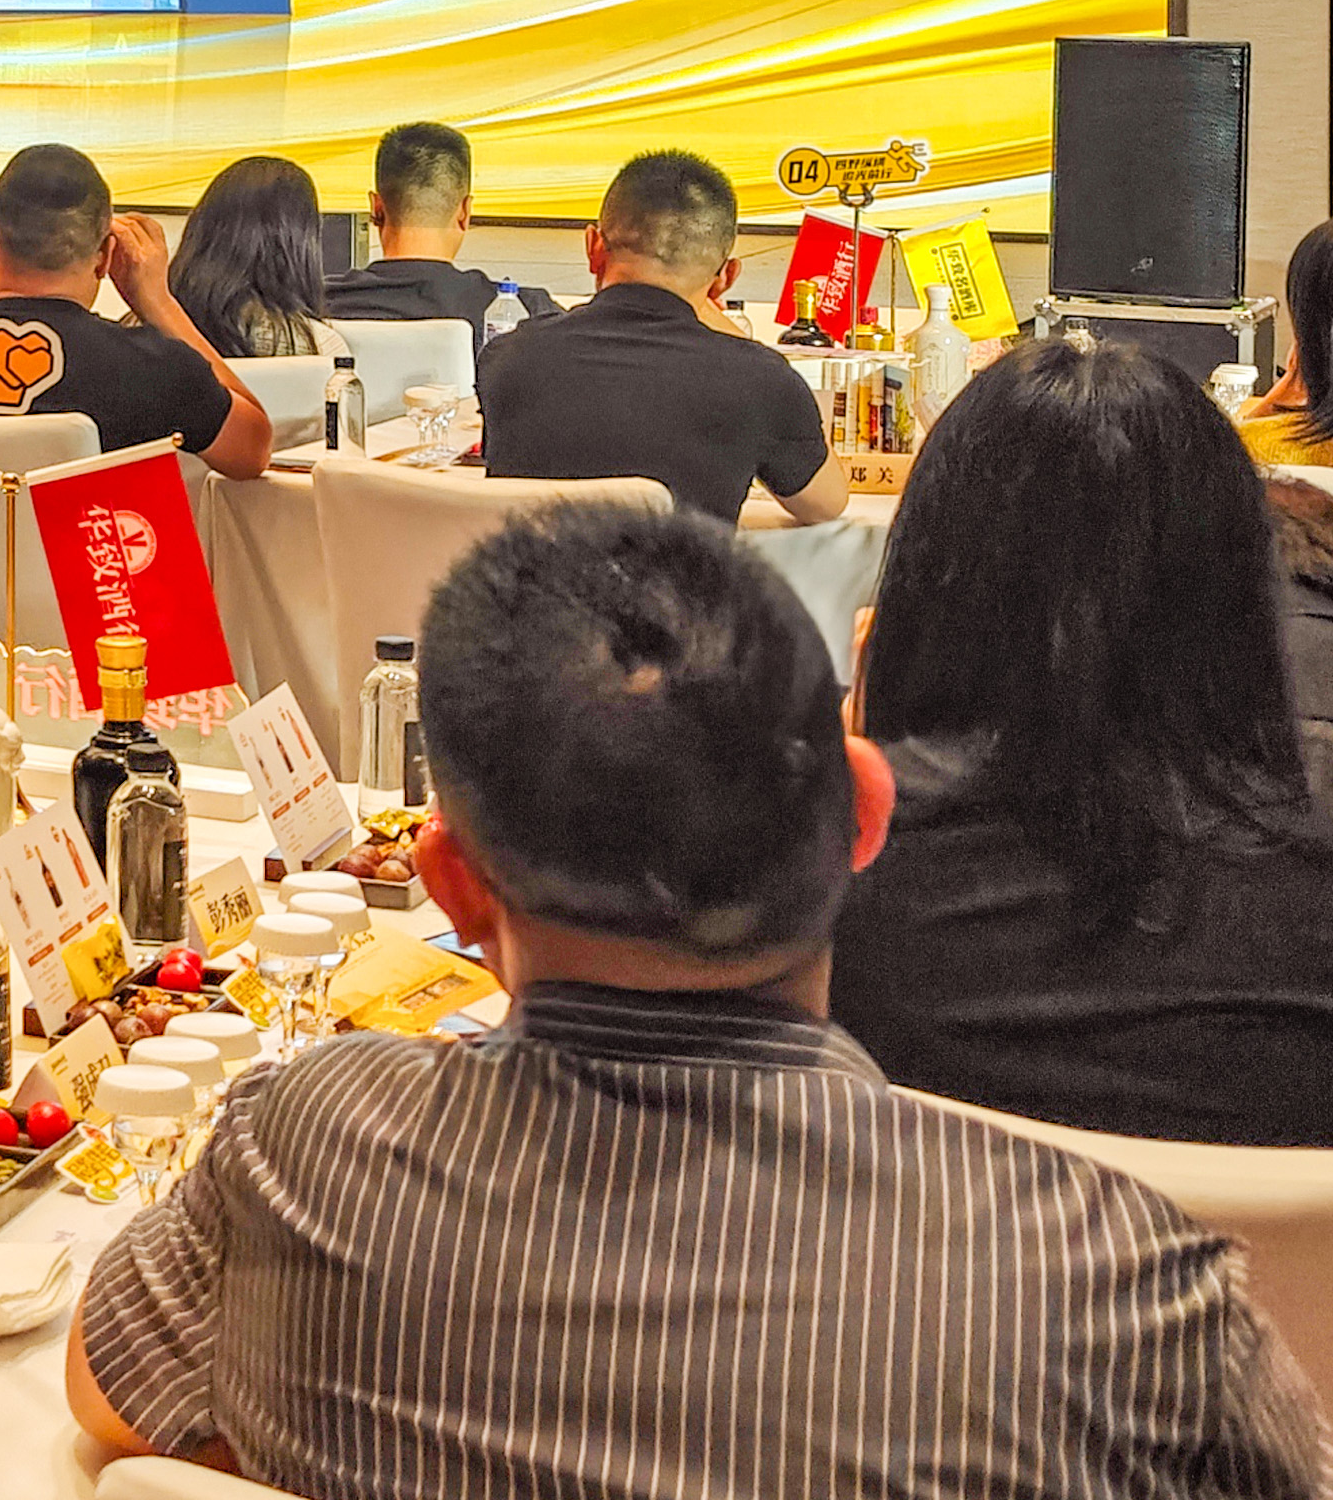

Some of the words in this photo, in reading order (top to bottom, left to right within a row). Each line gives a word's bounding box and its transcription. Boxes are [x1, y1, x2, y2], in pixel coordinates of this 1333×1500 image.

[788, 159, 819, 184] 04
[820, 240, 856, 317] 华致酒行
